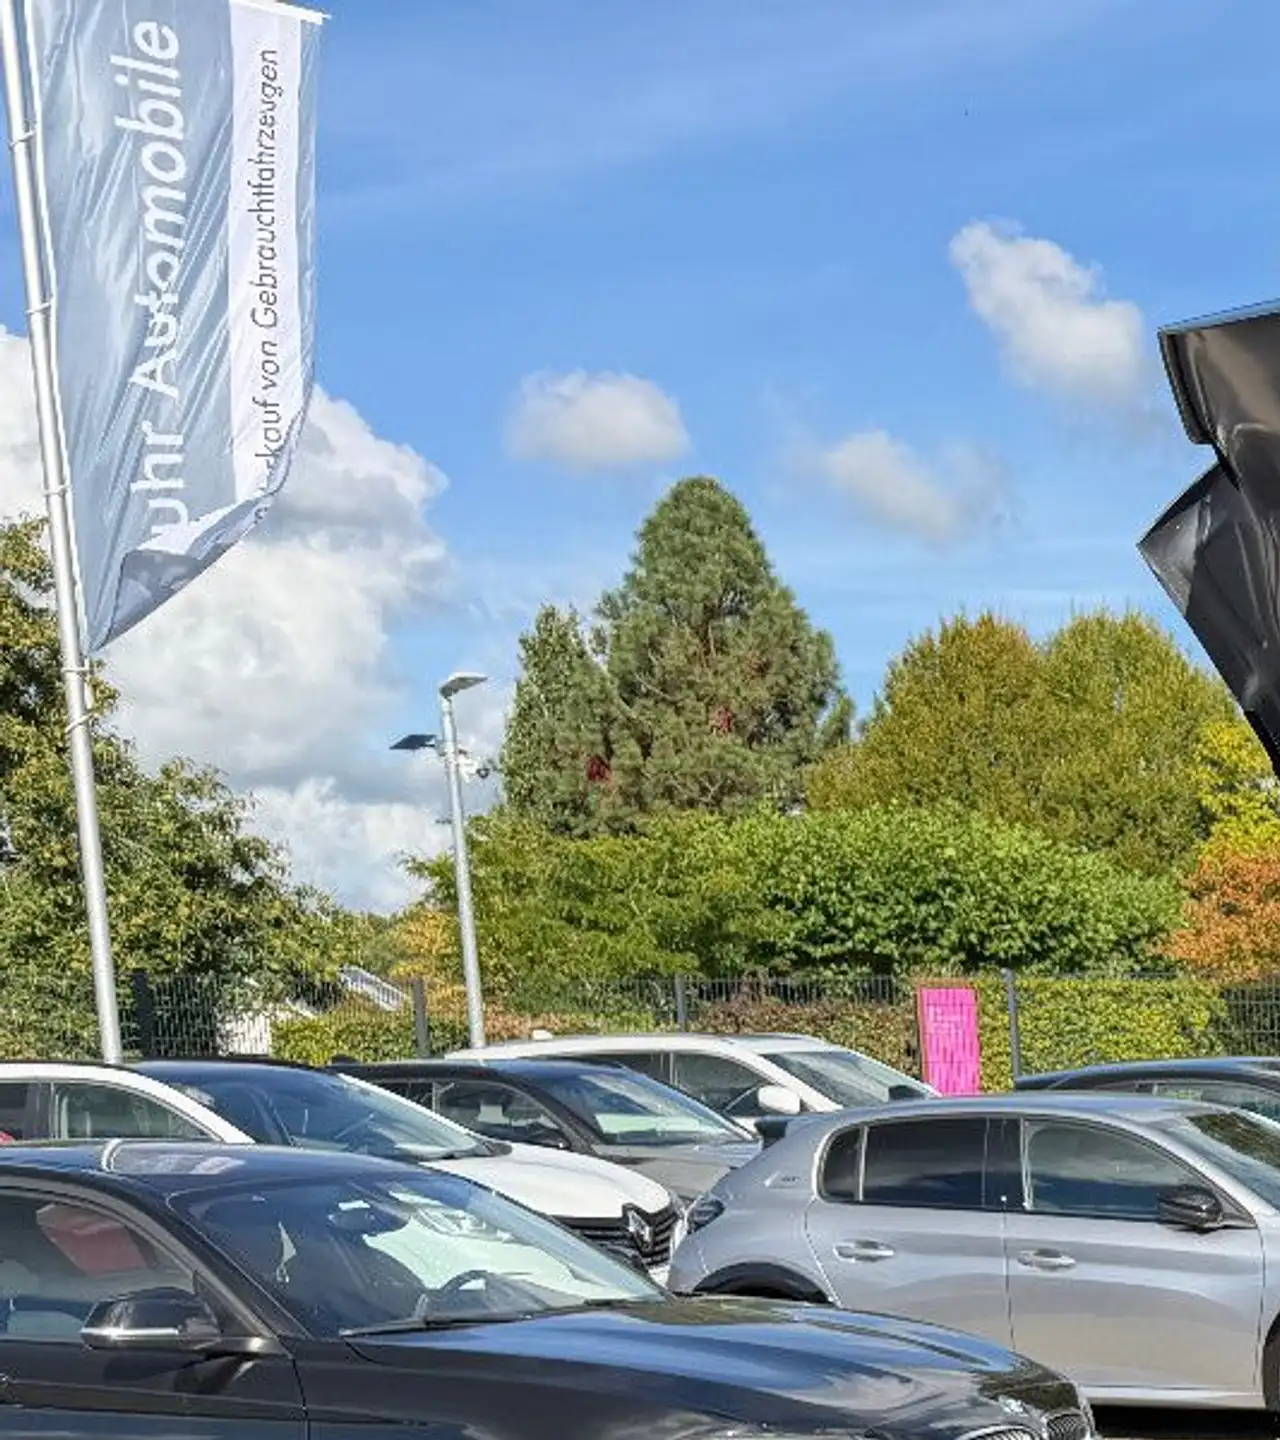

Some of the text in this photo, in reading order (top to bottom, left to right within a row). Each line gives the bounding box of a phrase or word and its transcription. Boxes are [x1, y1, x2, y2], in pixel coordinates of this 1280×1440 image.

[110, 21, 187, 399] Automobile
[247, 49, 284, 329] Gebrauchtfahrzeugen
[261, 340, 280, 393] von
